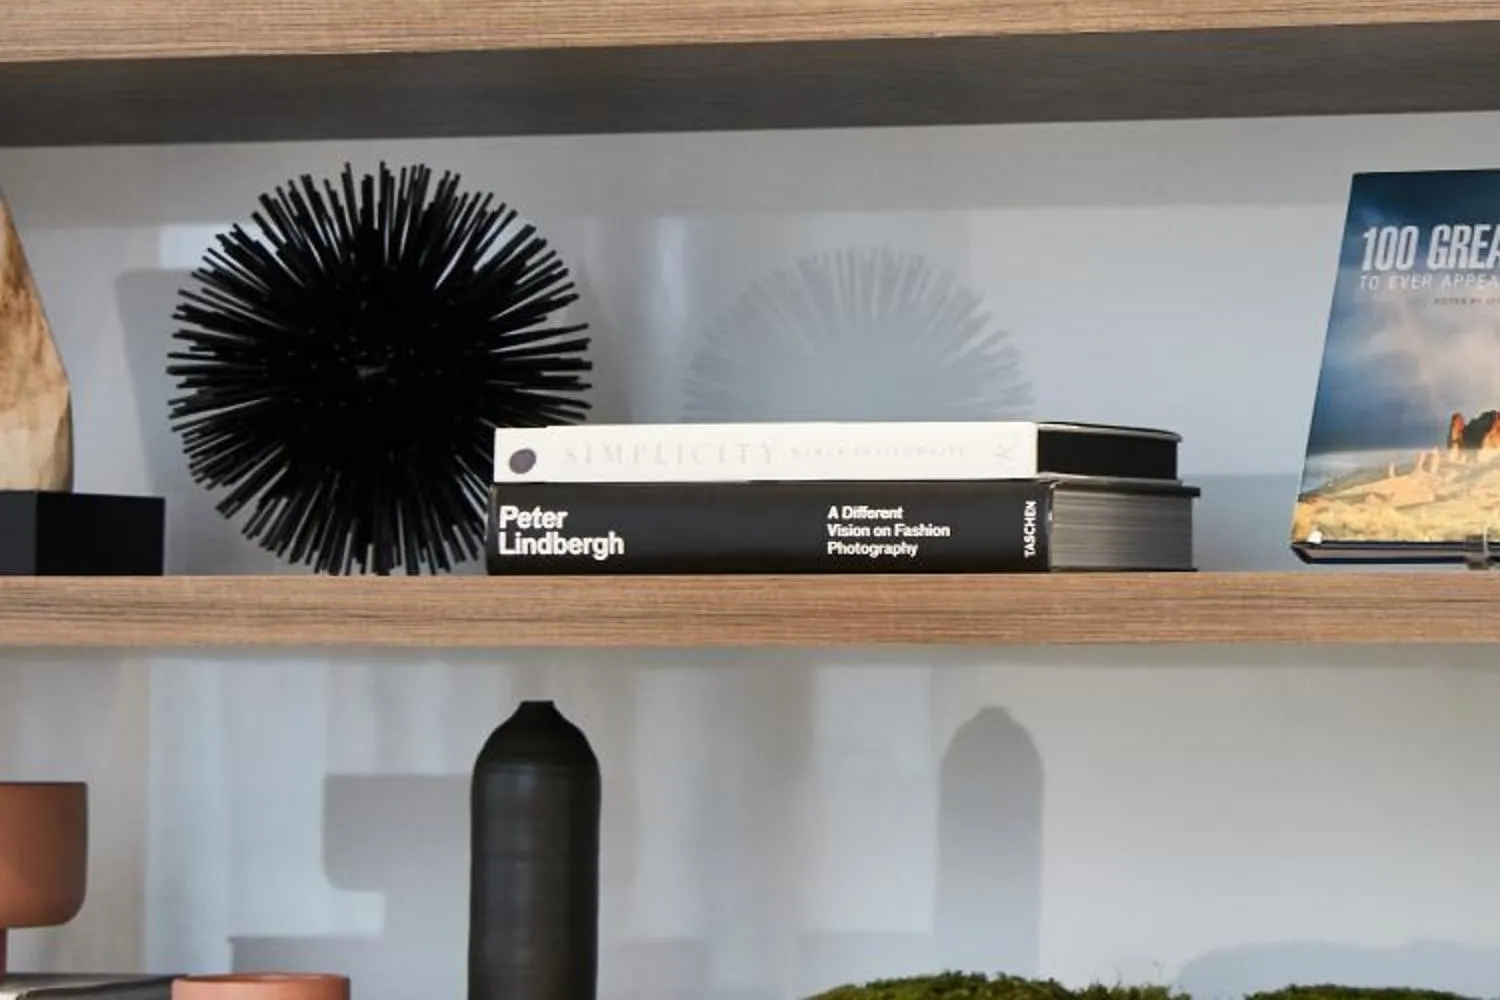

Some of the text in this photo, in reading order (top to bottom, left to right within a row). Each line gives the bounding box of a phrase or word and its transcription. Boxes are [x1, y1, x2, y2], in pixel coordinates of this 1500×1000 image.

[1362, 225, 1419, 272] 100
[1359, 275, 1380, 291] TO
[1388, 274, 1432, 290] EVER
[563, 441, 774, 467] SIMPLICITY
[499, 505, 568, 529] Peter
[827, 505, 904, 520] A Different
[827, 523, 951, 537] Vision on Fashion
[1024, 500, 1037, 558] TASCHEN
[499, 531, 625, 561] Lindbergh
[827, 541, 918, 558] Photography
